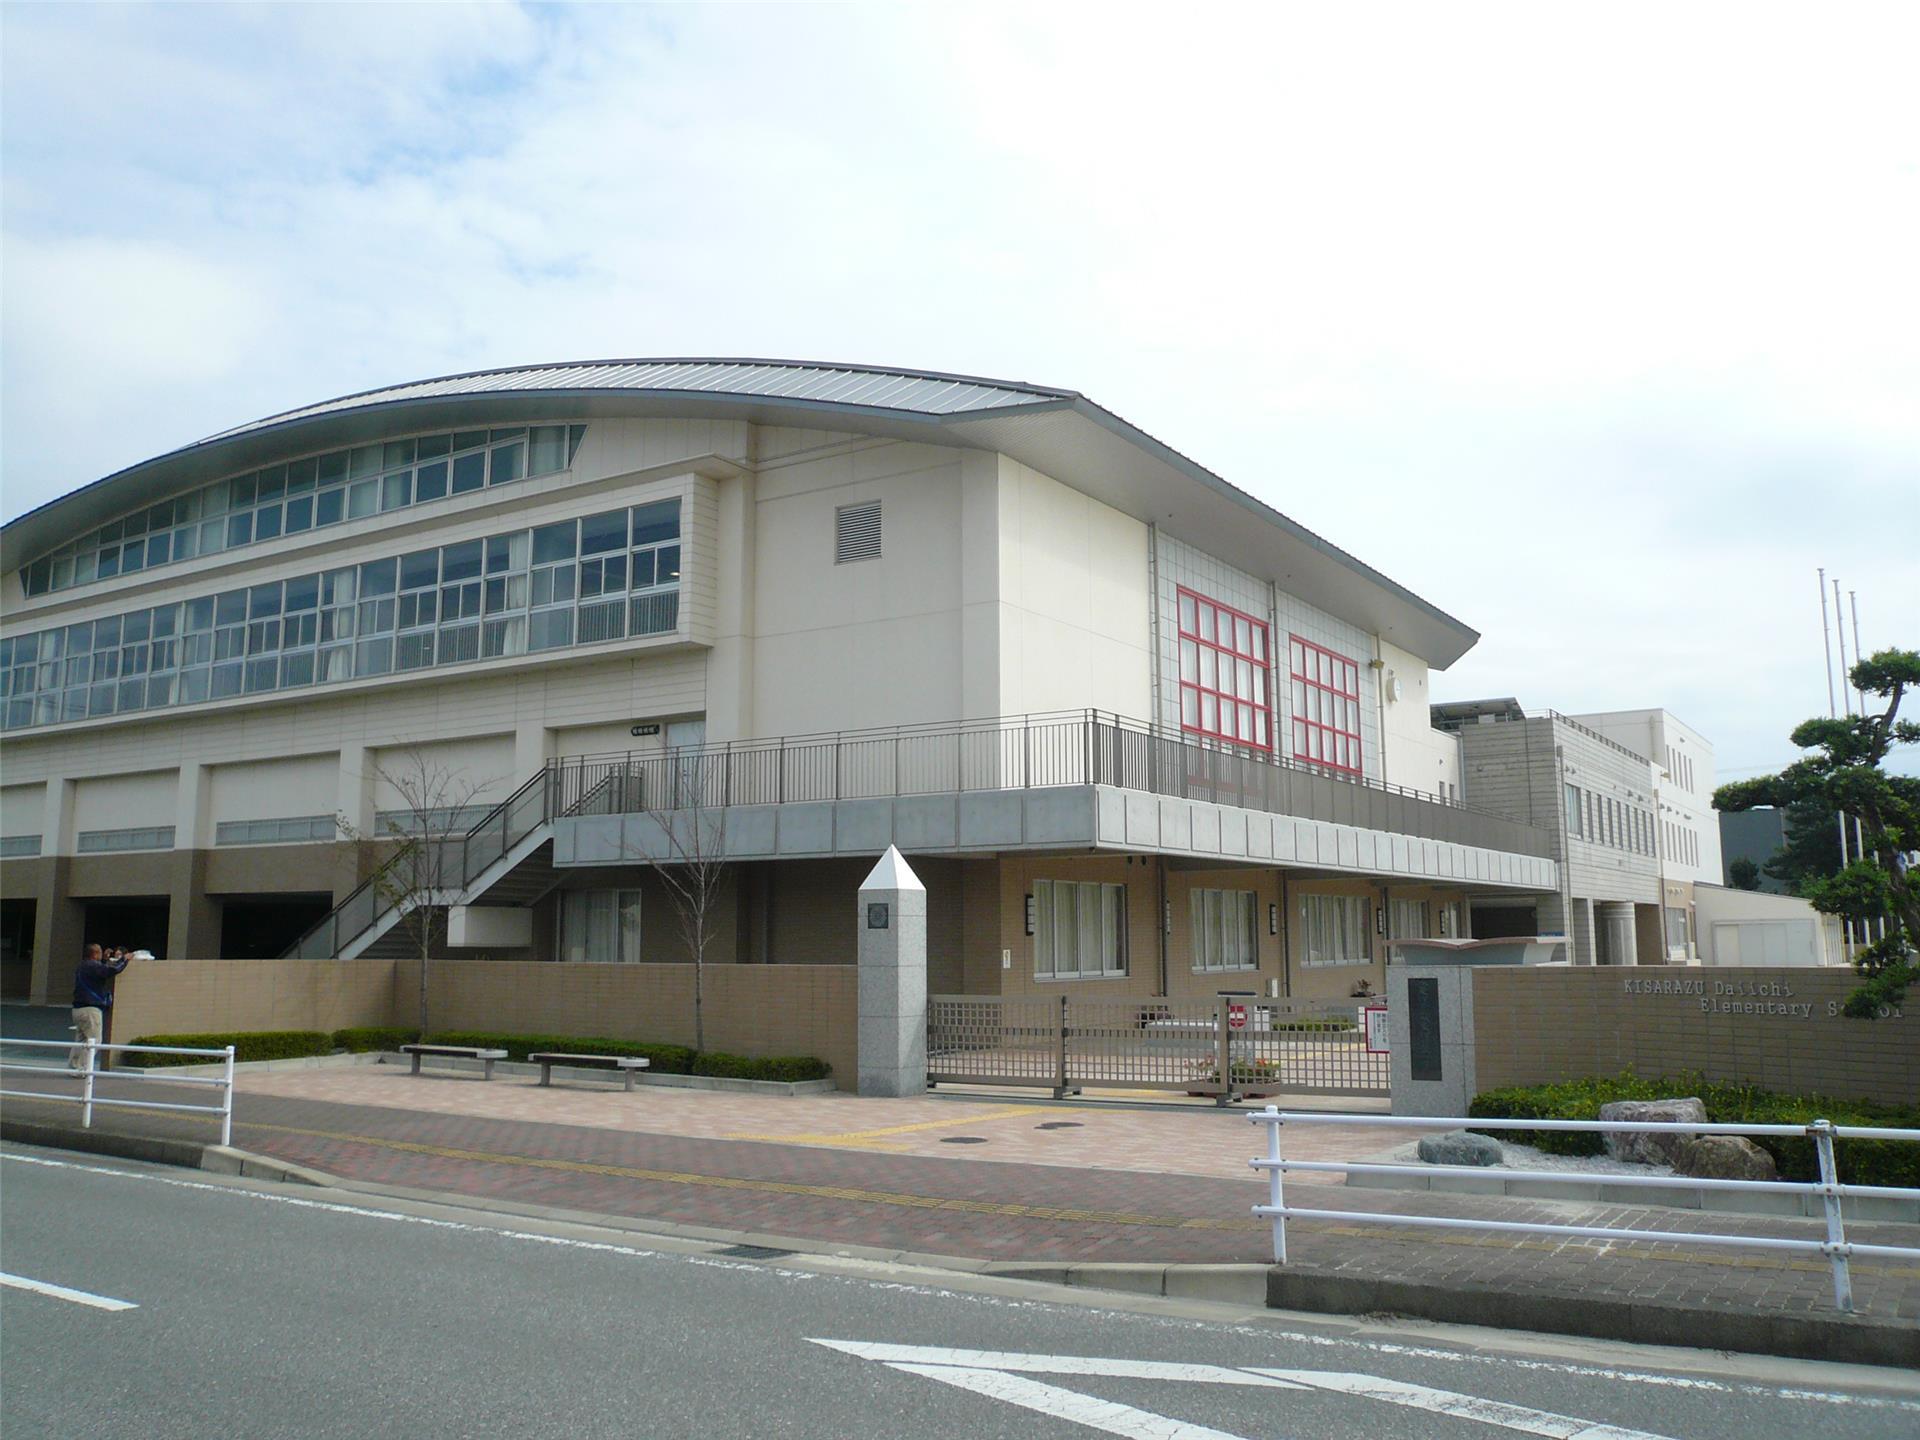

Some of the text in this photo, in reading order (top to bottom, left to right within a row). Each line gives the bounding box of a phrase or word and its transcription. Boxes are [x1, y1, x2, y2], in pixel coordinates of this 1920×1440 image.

[1624, 979, 1793, 997] KISARAZU Daiichi
[1701, 998, 1903, 1018] Elementary Sol
